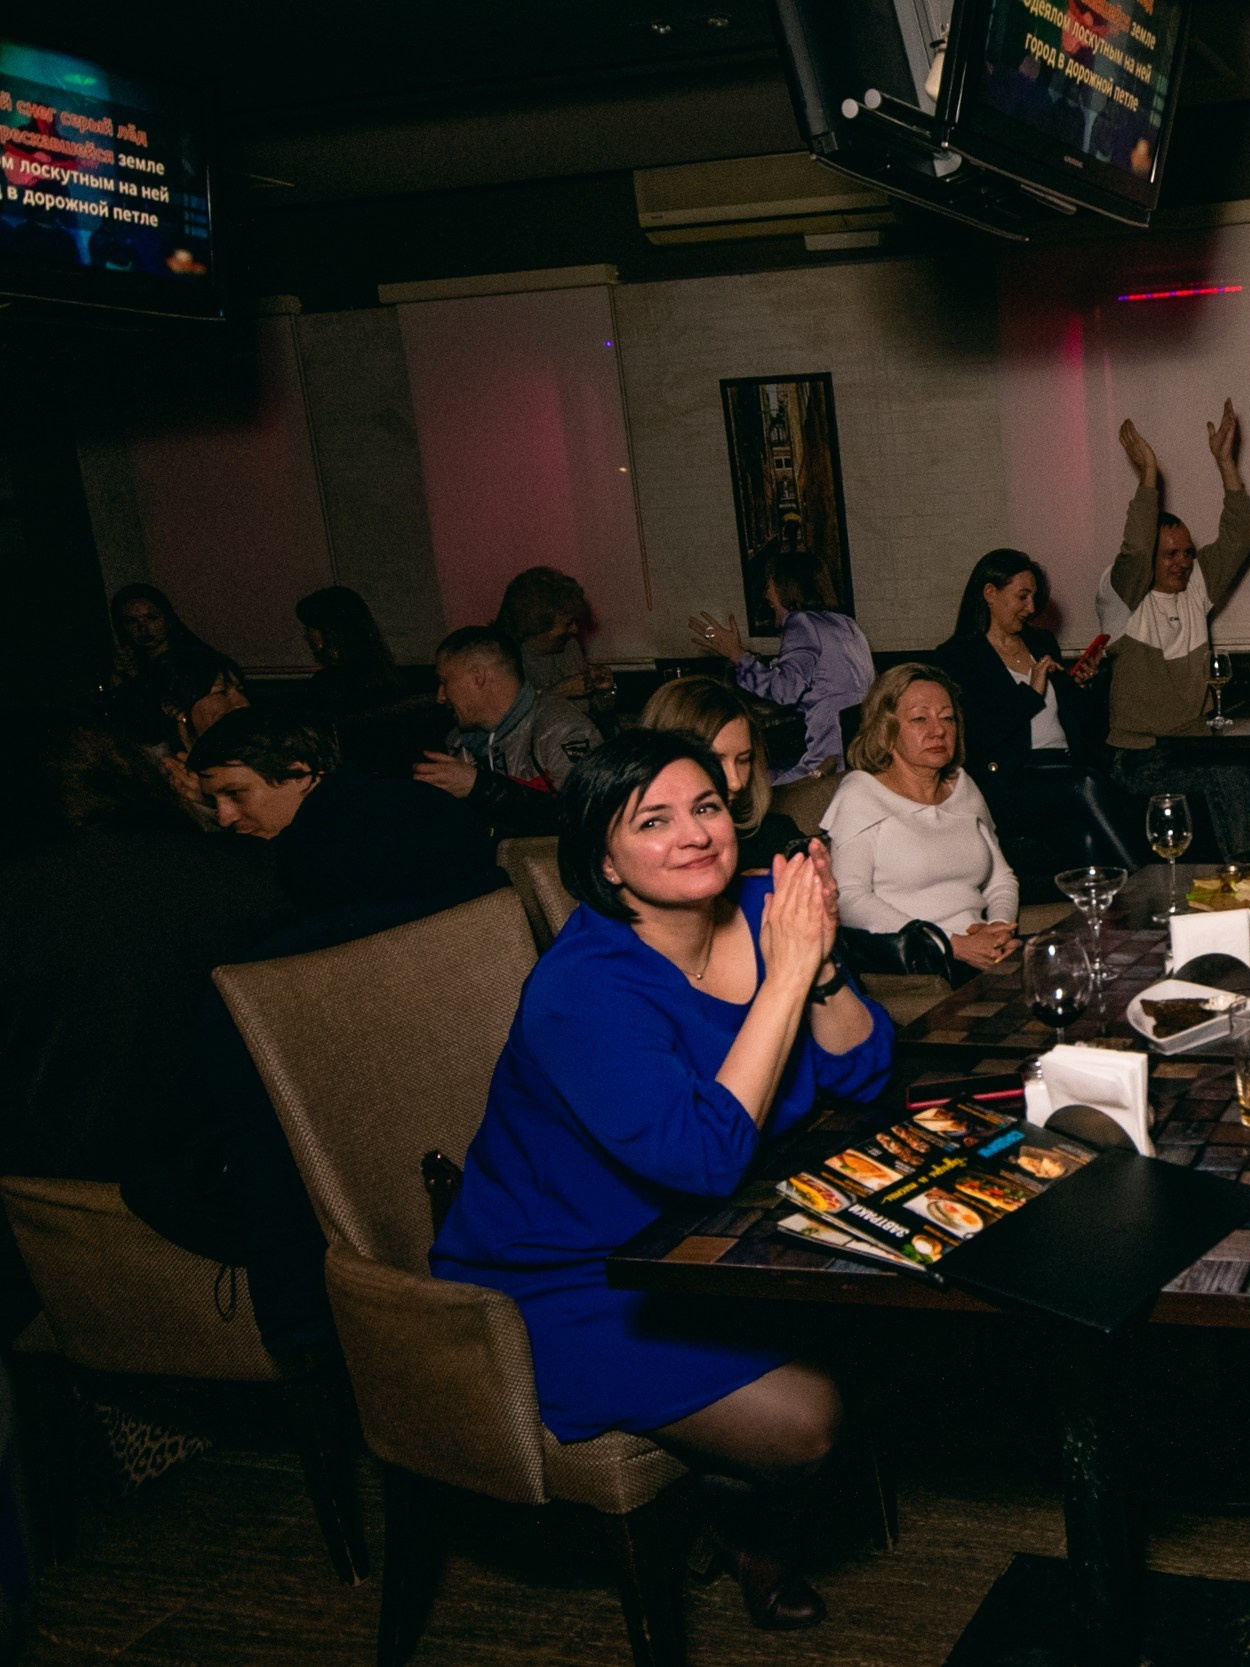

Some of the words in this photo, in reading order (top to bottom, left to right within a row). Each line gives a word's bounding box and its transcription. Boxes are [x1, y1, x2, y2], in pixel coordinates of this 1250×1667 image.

[1071, 21, 1124, 66] лоскутным
[1123, 56, 1136, 74] на
[1135, 63, 1153, 84] ней
[1129, 21, 1157, 51] земле
[1024, 32, 1058, 69] город
[1057, 53, 1066, 69] в
[1065, 58, 1115, 98] дорожной
[1113, 86, 1139, 113] петле
[20, 159, 115, 192] лоскутным
[119, 181, 138, 197] на
[141, 185, 170, 204] ней
[118, 153, 165, 175] земле
[7, 185, 18, 200] в
[23, 189, 109, 218] дорожной
[112, 206, 159, 228] петле
[847, 1203, 911, 1239] ЗАВТРАКИ
